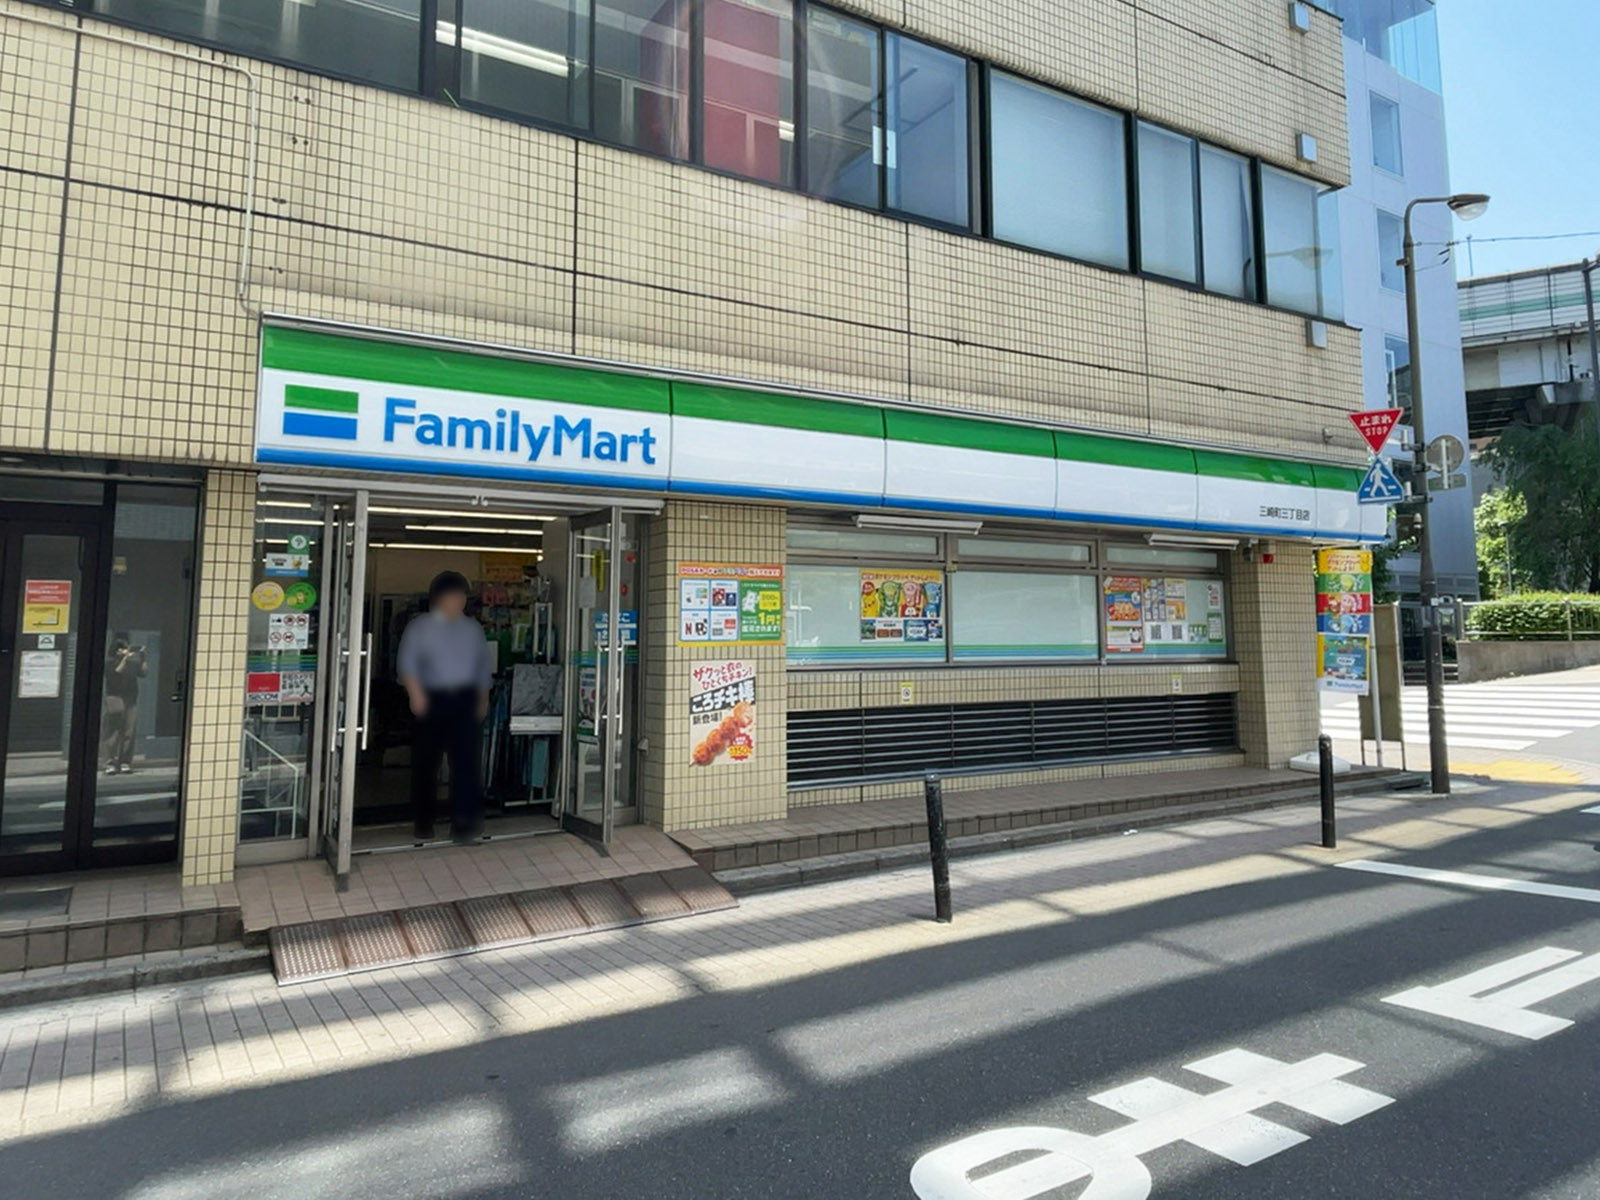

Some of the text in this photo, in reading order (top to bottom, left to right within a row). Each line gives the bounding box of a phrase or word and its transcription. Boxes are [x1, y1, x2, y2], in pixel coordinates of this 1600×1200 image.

[1360, 414, 1392, 427] 止まれ
[383, 397, 657, 465] FamilyMart
[1365, 426, 1388, 437] STOP
